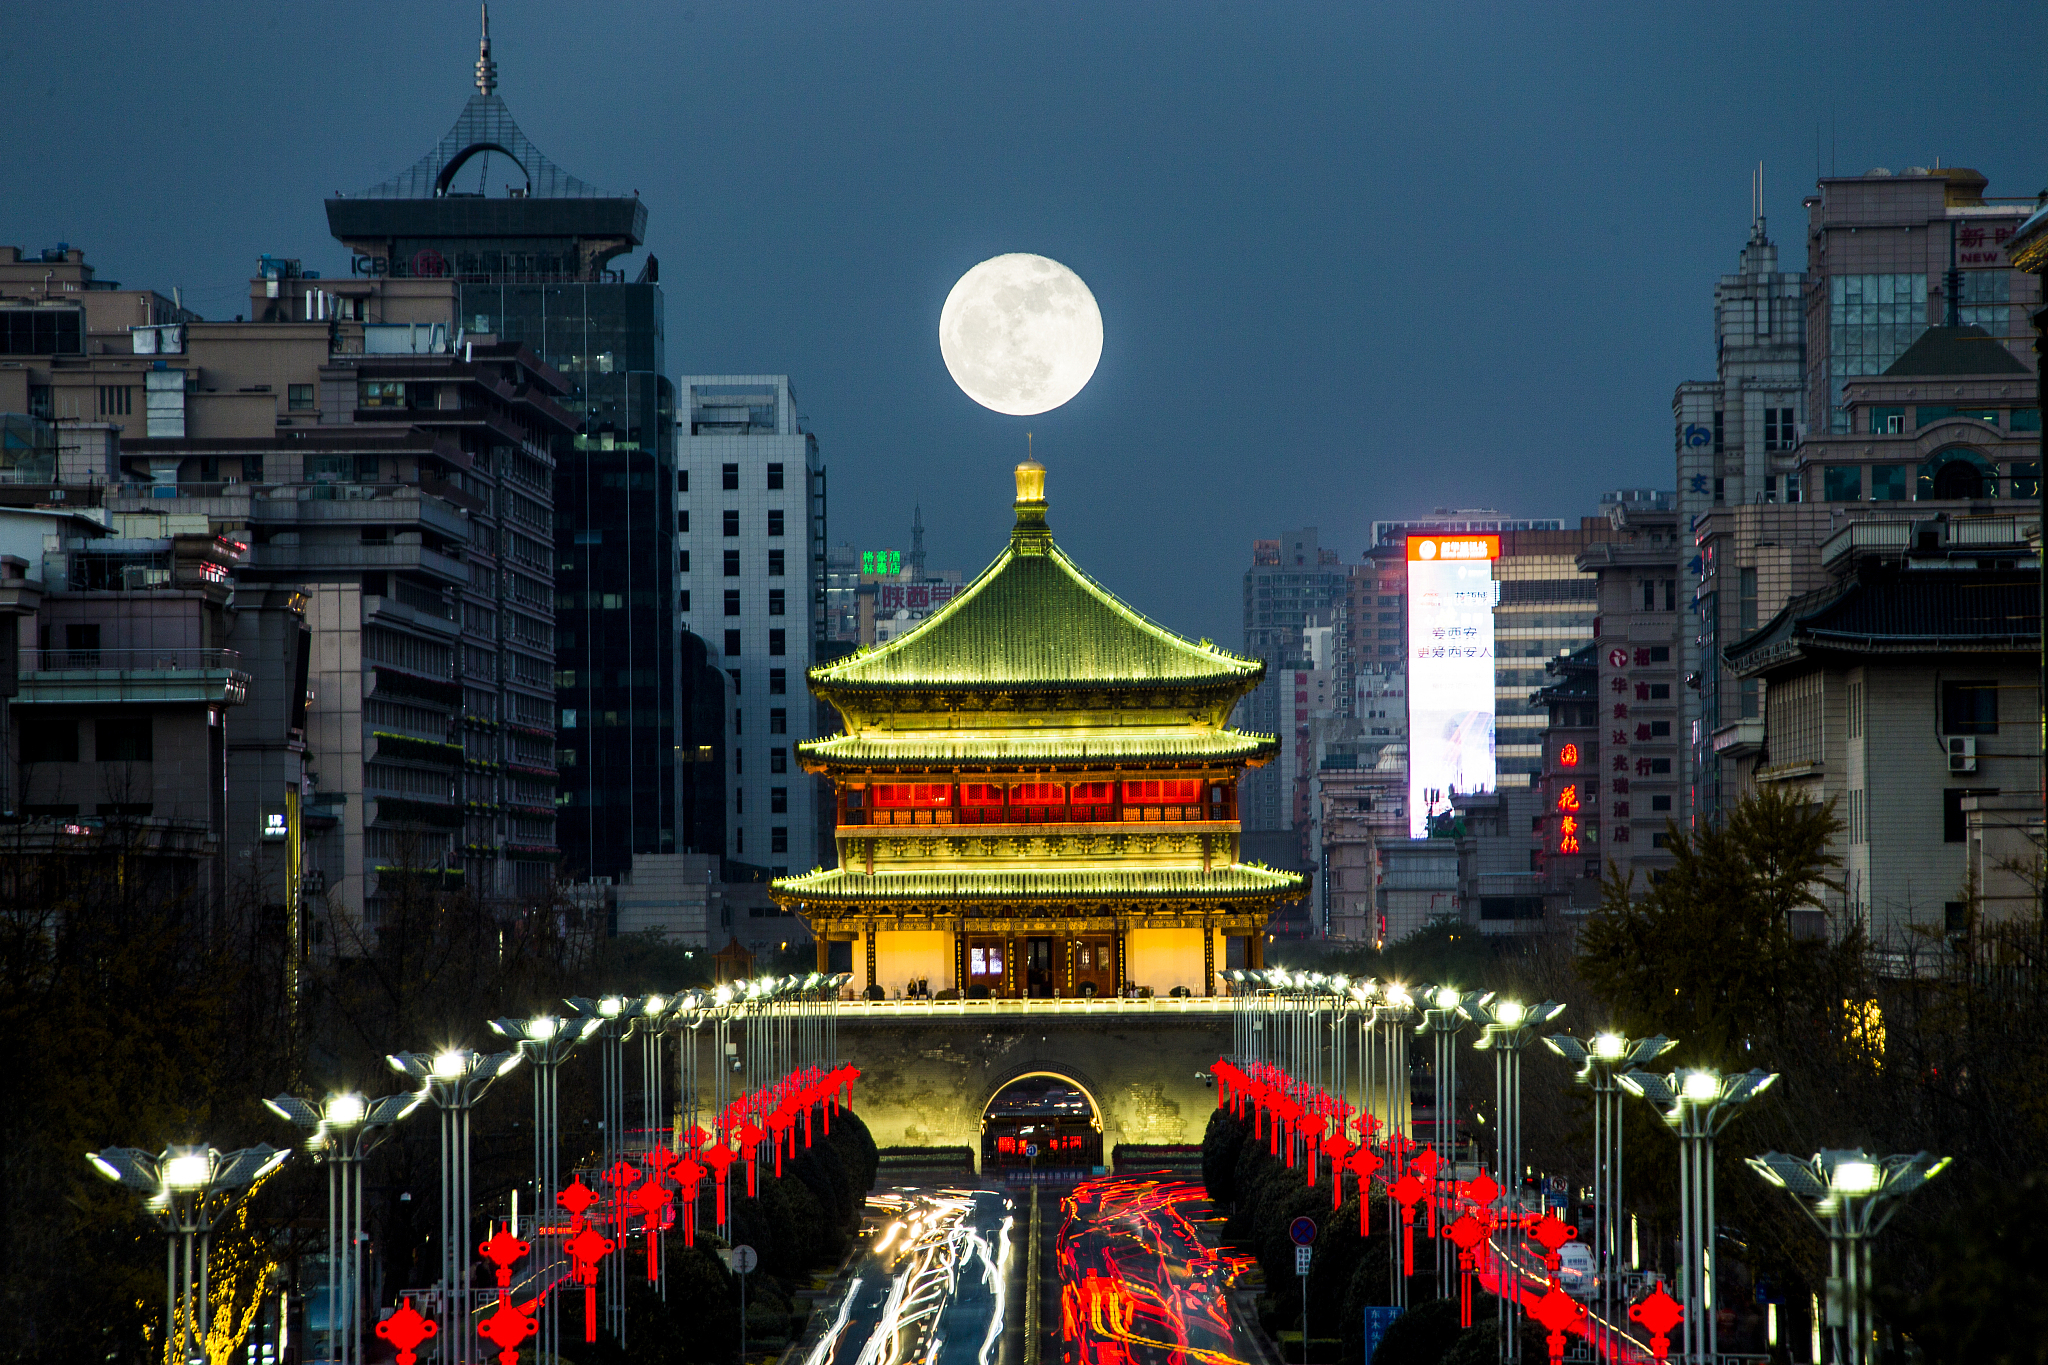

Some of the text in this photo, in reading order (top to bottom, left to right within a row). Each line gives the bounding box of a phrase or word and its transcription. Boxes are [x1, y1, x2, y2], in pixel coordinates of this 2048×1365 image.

[1960, 253, 1998, 263] NEW
[1611, 676, 1630, 843] 华美达兆瑞酒店
[1633, 647, 1653, 777] 招商银行
